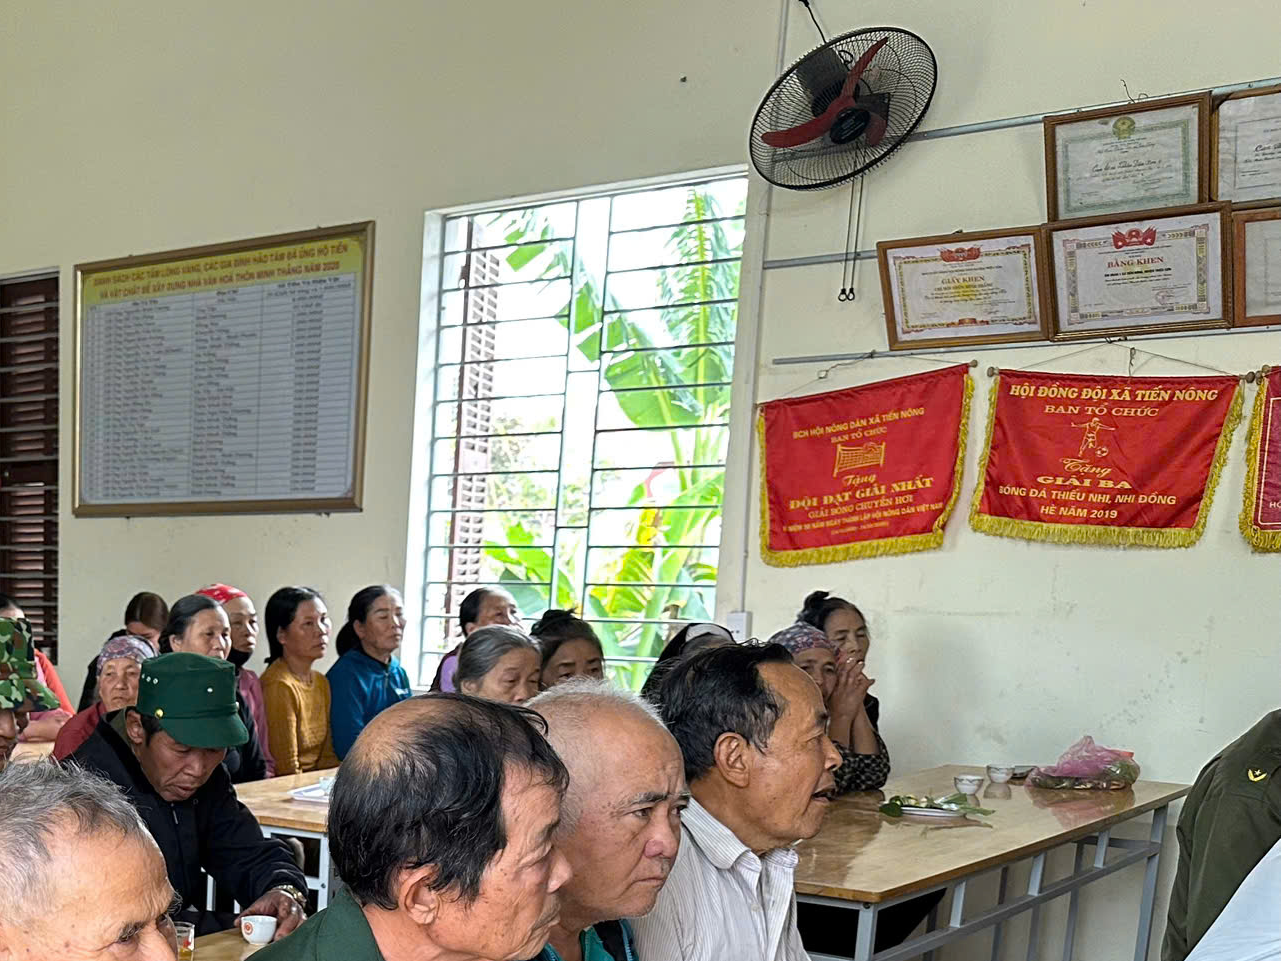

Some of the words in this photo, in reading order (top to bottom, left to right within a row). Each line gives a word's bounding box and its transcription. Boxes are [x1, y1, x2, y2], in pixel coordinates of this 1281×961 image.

[1136, 256, 1164, 265] KHEN
[1010, 383, 1036, 398] HỘI
[1037, 381, 1079, 399] ĐỒNG
[1080, 386, 1107, 401] ĐỘI
[1109, 386, 1131, 400] XÃ
[1135, 385, 1171, 401] TIẾN
[1172, 386, 1219, 401] NÔNG
[1044, 405, 1081, 415] BAN
[1084, 402, 1109, 415] TỔ
[1111, 405, 1160, 417] CHỨC
[810, 426, 824, 437] HỘI
[825, 423, 849, 433] NÔNG
[850, 418, 867, 429] DÂN
[869, 413, 881, 425] XÃ
[882, 410, 899, 422] TIẾN
[900, 407, 924, 418] NÔNG
[831, 434, 849, 443] BAN
[851, 428, 863, 439] TỔ
[864, 426, 888, 437] CHỨC
[1060, 458, 1113, 478] Tặng
[843, 474, 876, 488] Tặng
[1036, 474, 1093, 488] GIẢI
[1098, 479, 1132, 489] BA
[790, 496, 818, 510] ĐỘI
[823, 491, 852, 505] ĐẠT
[855, 485, 886, 499] GIẢI
[891, 475, 934, 493] NHẤT
[999, 484, 1026, 497] BÓNG
[1028, 487, 1048, 498] ĐÁ
[1050, 487, 1086, 502] THIẾU
[1088, 493, 1112, 504] NHI,
[1115, 494, 1135, 503] NHI
[1138, 490, 1177, 505] ĐỒNG
[1040, 504, 1056, 515] HÈ
[1059, 505, 1088, 518] NĂM
[1089, 509, 1118, 519] 2019
